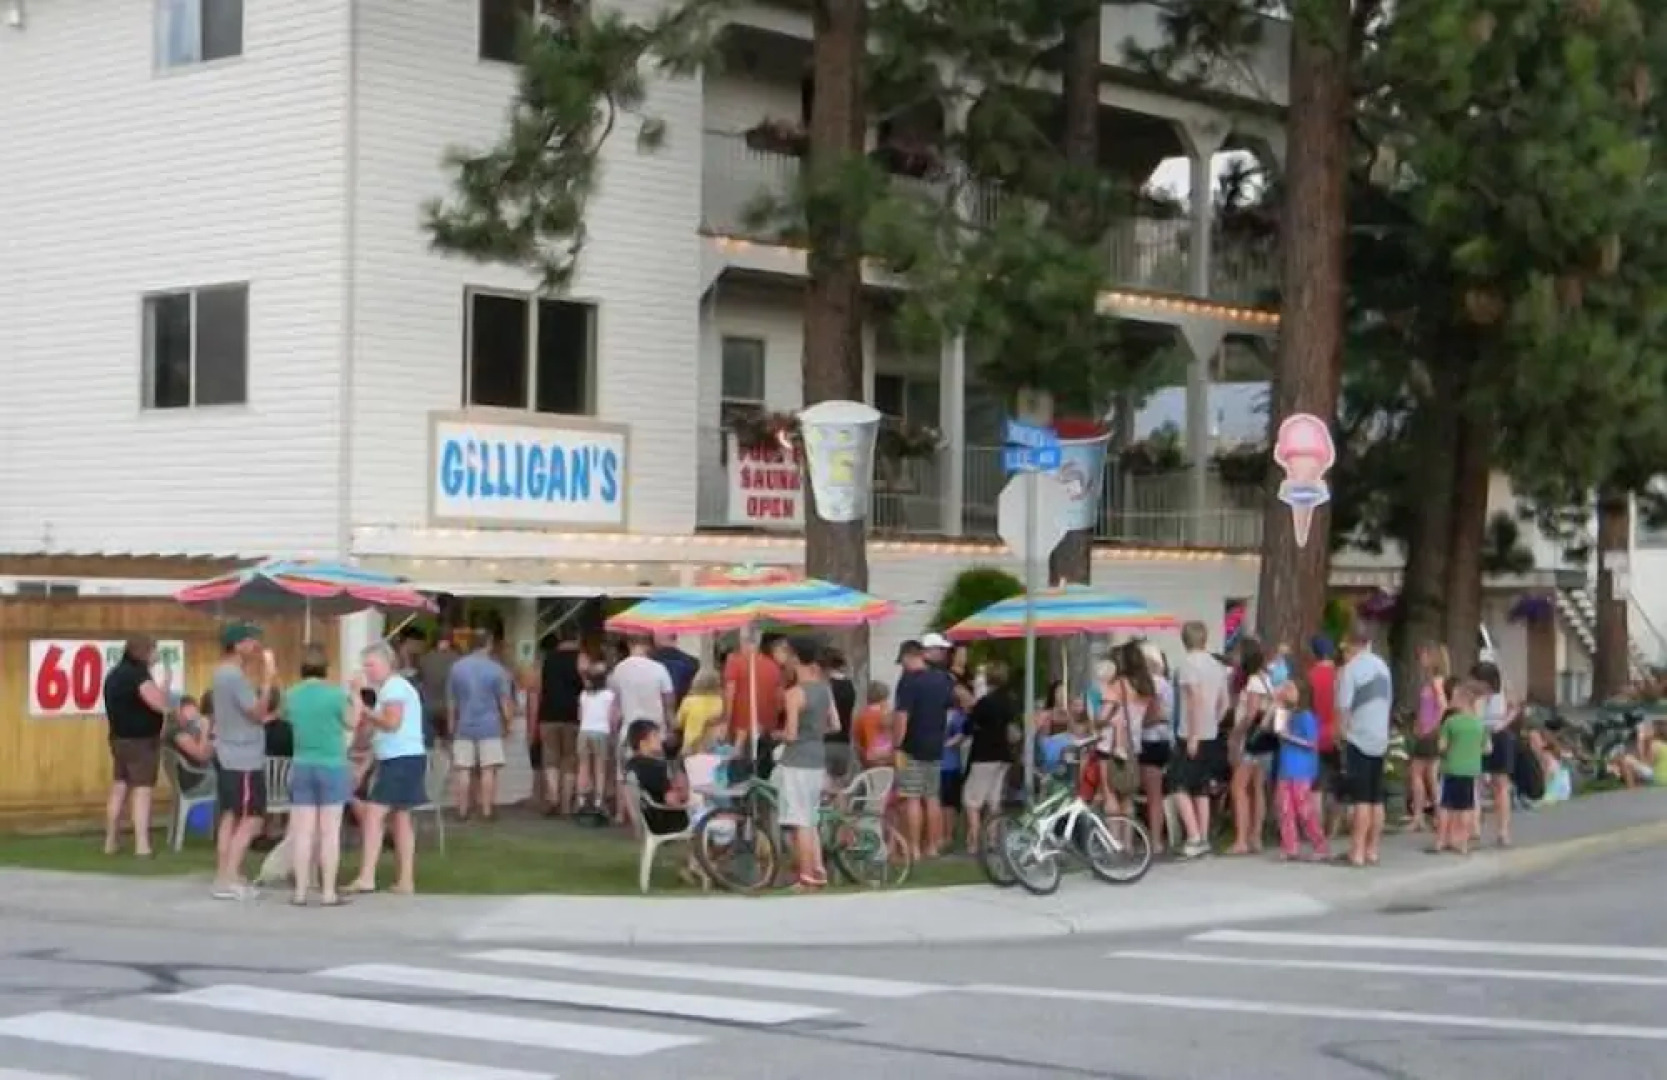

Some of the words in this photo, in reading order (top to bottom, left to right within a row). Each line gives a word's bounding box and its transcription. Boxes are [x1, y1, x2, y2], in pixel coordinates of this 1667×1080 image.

[740, 467, 801, 490] SAUNA
[746, 496, 794, 518] OPEN
[36, 643, 103, 711] 60
